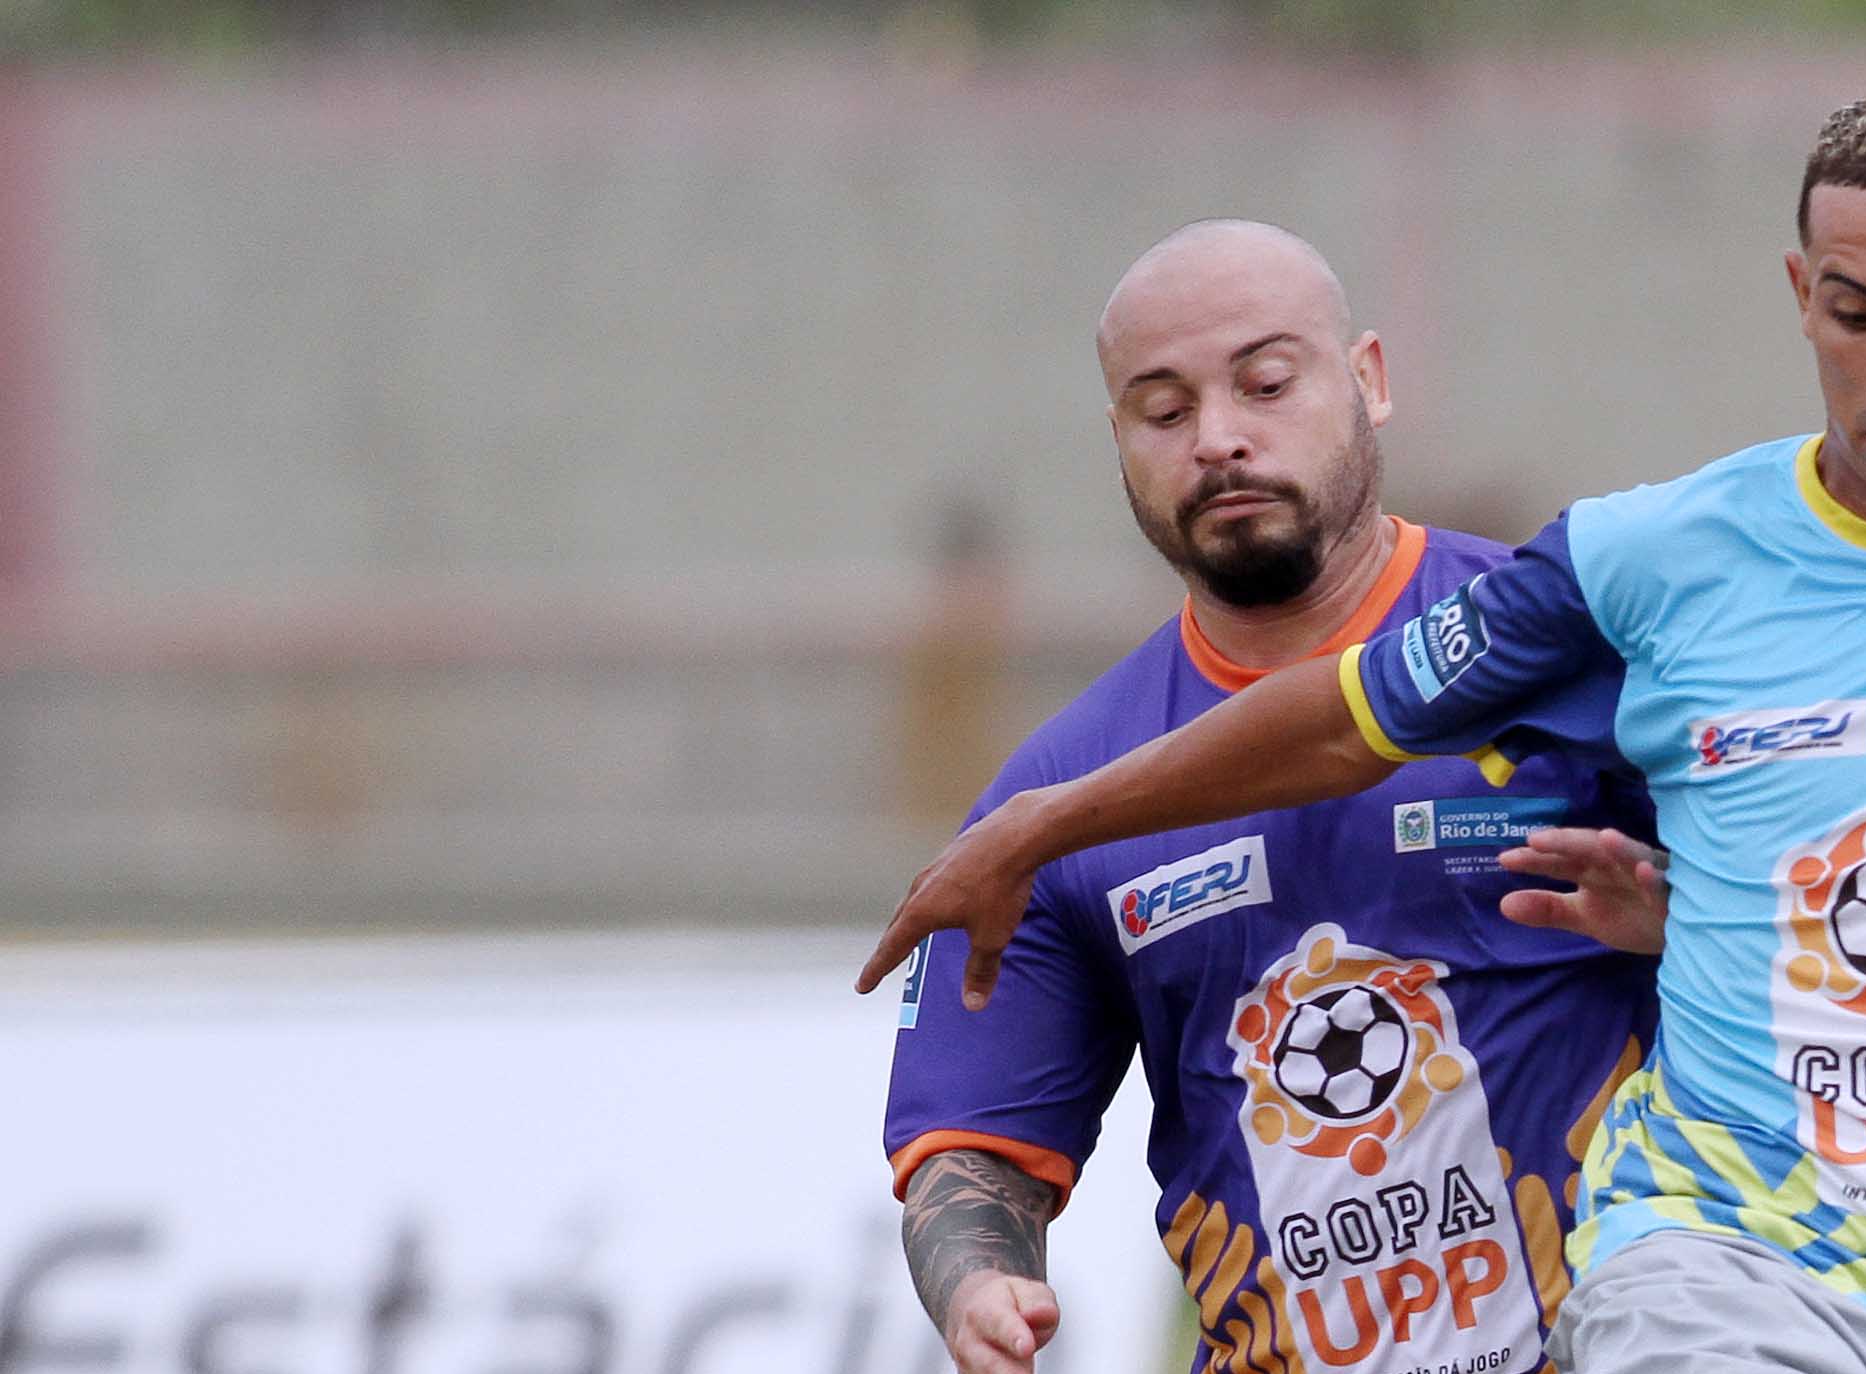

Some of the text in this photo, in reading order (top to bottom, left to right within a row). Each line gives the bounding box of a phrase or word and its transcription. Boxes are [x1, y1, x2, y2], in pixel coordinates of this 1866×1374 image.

[1438, 603, 1471, 663] RIO
[1719, 711, 1853, 757] FERJ
[1440, 811, 1510, 823] GOVERNO DO
[1440, 823, 1471, 839] Rio
[1474, 822, 1497, 837] de
[1146, 854, 1252, 922] FERJ
[1278, 1164, 1496, 1280] COPA
[1296, 1239, 1508, 1367] UPP
[1466, 1347, 1511, 1374] JOGO
